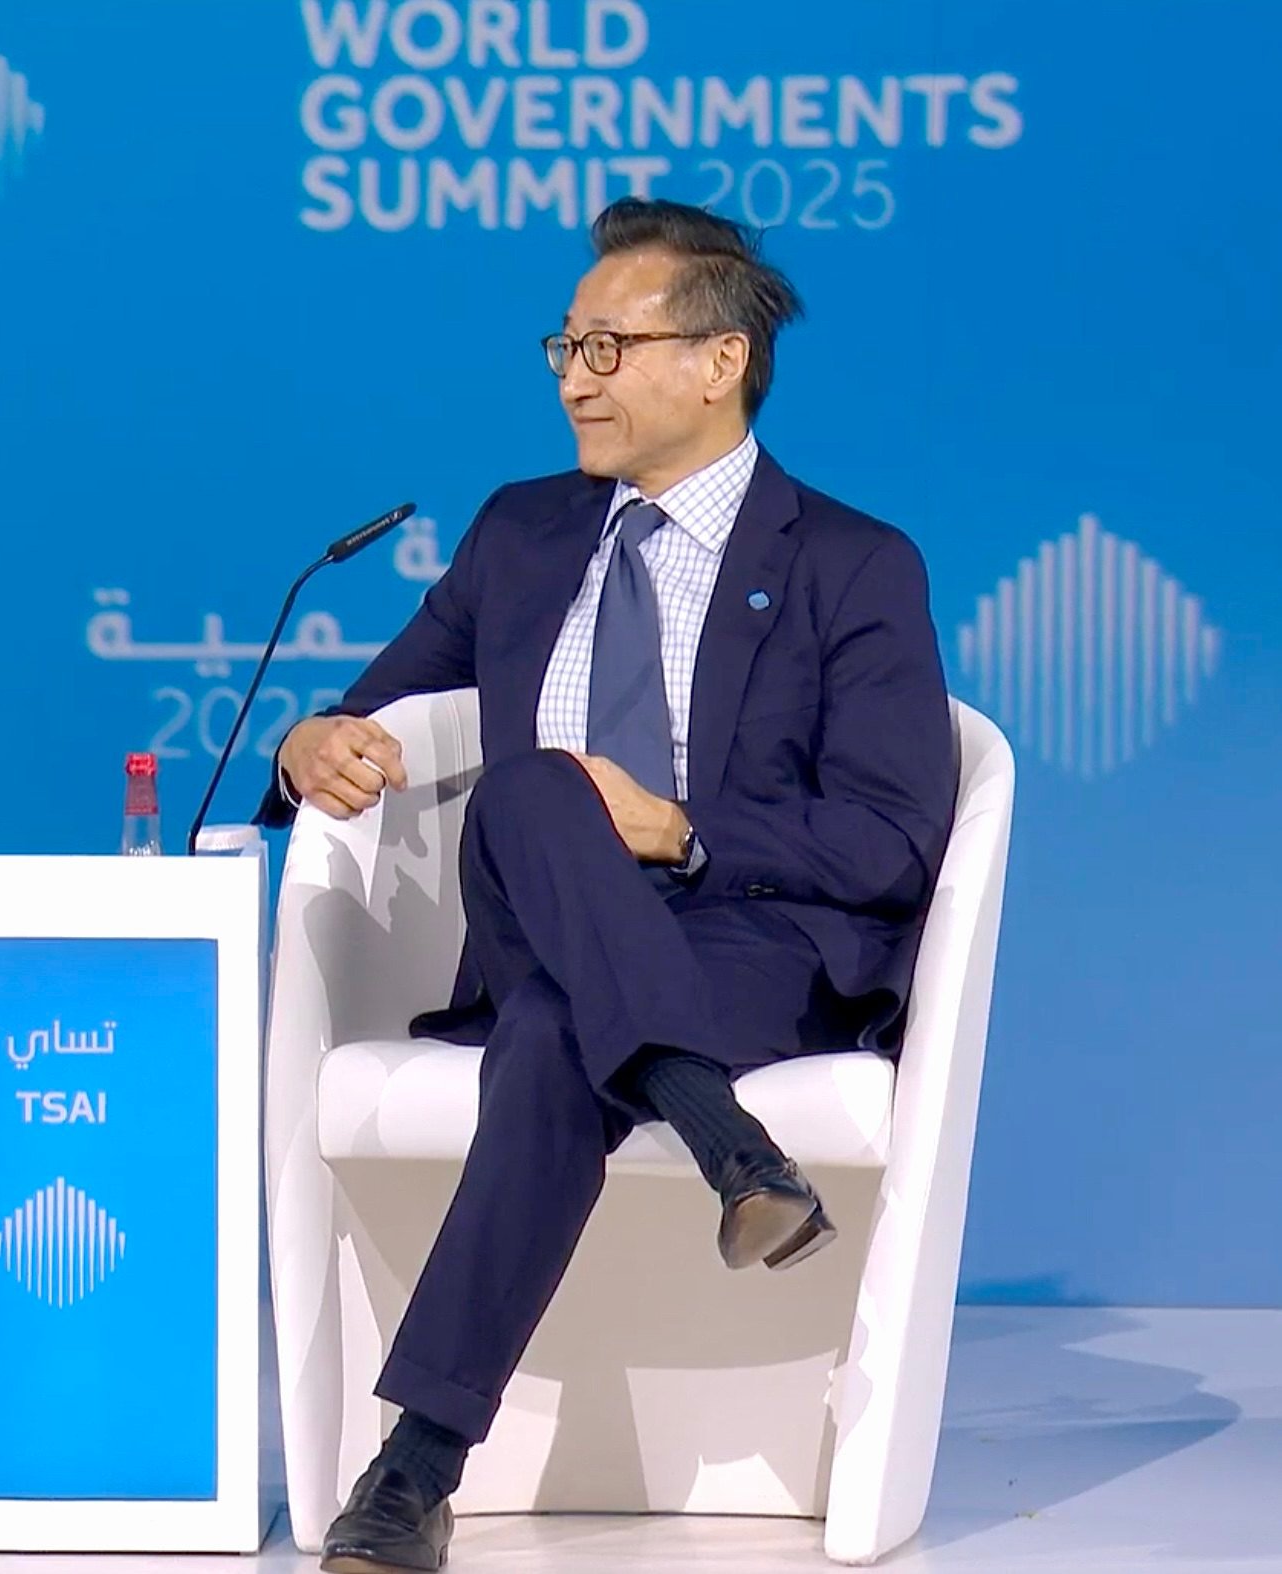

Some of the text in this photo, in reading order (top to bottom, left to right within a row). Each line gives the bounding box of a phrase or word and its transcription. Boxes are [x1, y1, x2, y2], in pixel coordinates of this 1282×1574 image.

[300, 0, 648, 68] WORLD
[301, 74, 1023, 149] GOVERNMENTS
[301, 156, 897, 231] SUMMIT 2025
[7, 1018, 118, 1070] تساي
[15, 1090, 107, 1124] TSAI
